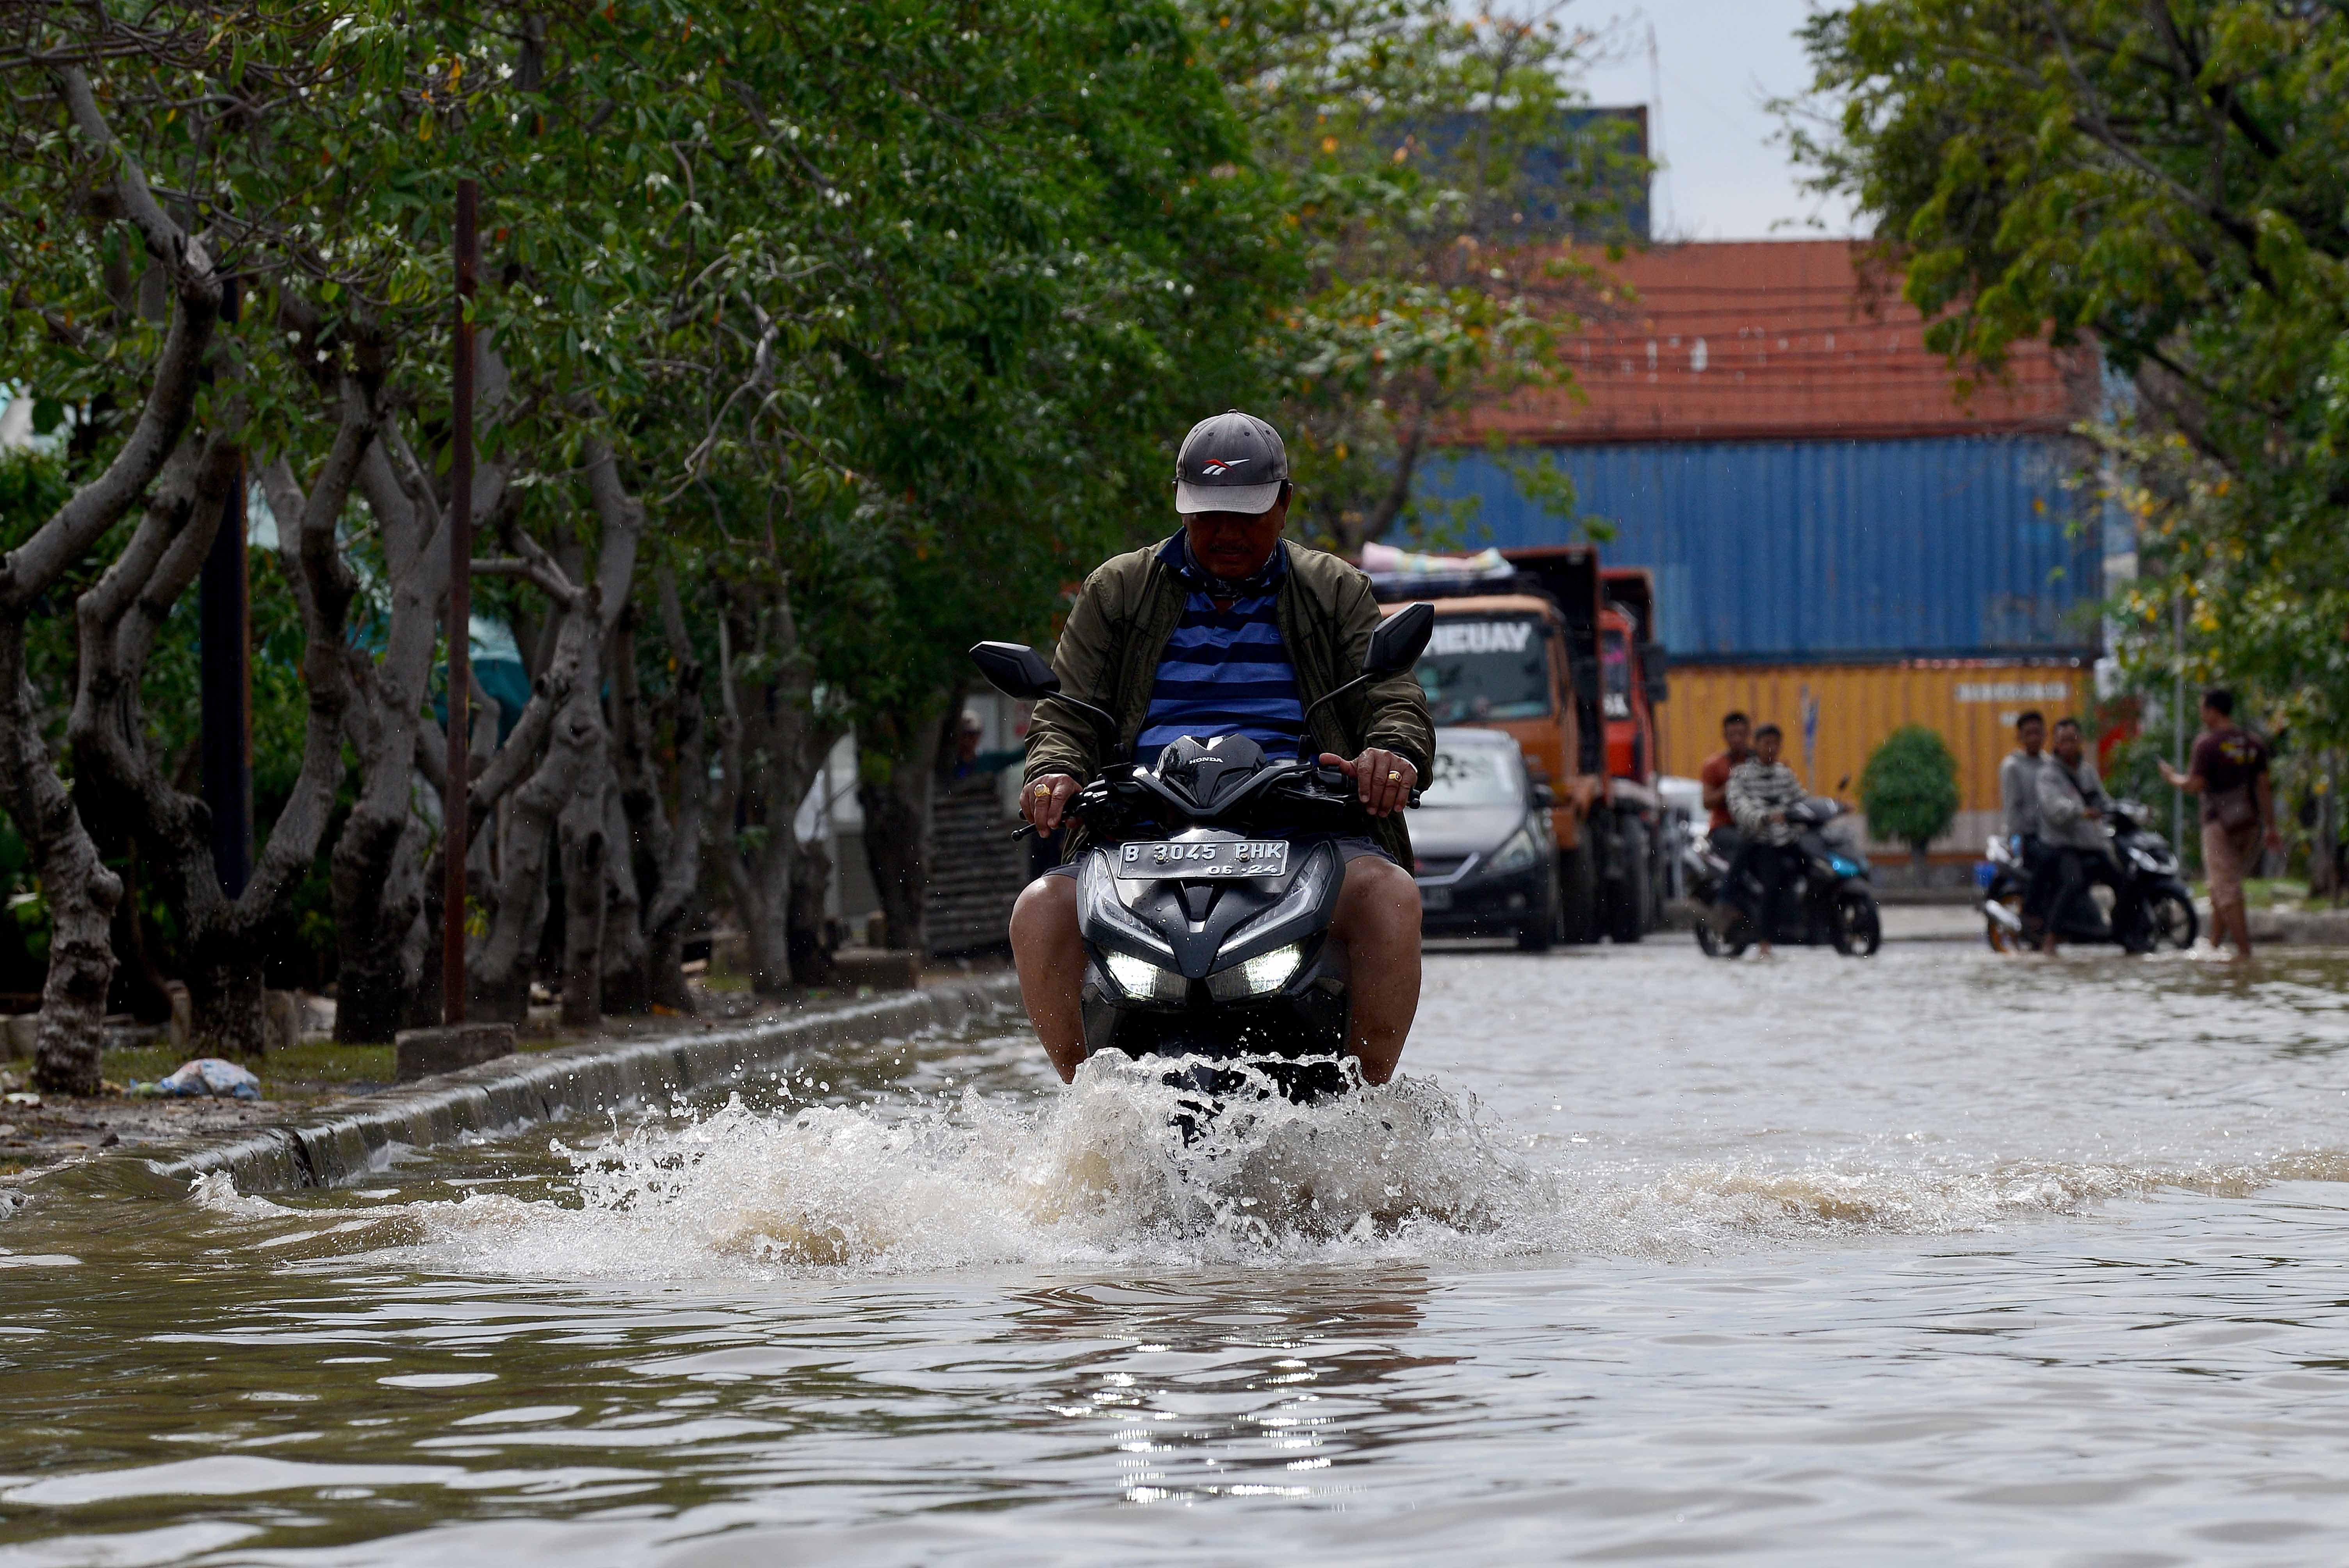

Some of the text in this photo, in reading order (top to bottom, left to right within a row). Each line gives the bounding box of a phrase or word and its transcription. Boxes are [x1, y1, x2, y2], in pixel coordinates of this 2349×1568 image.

[1125, 843, 1283, 862] B 3045 PHK
